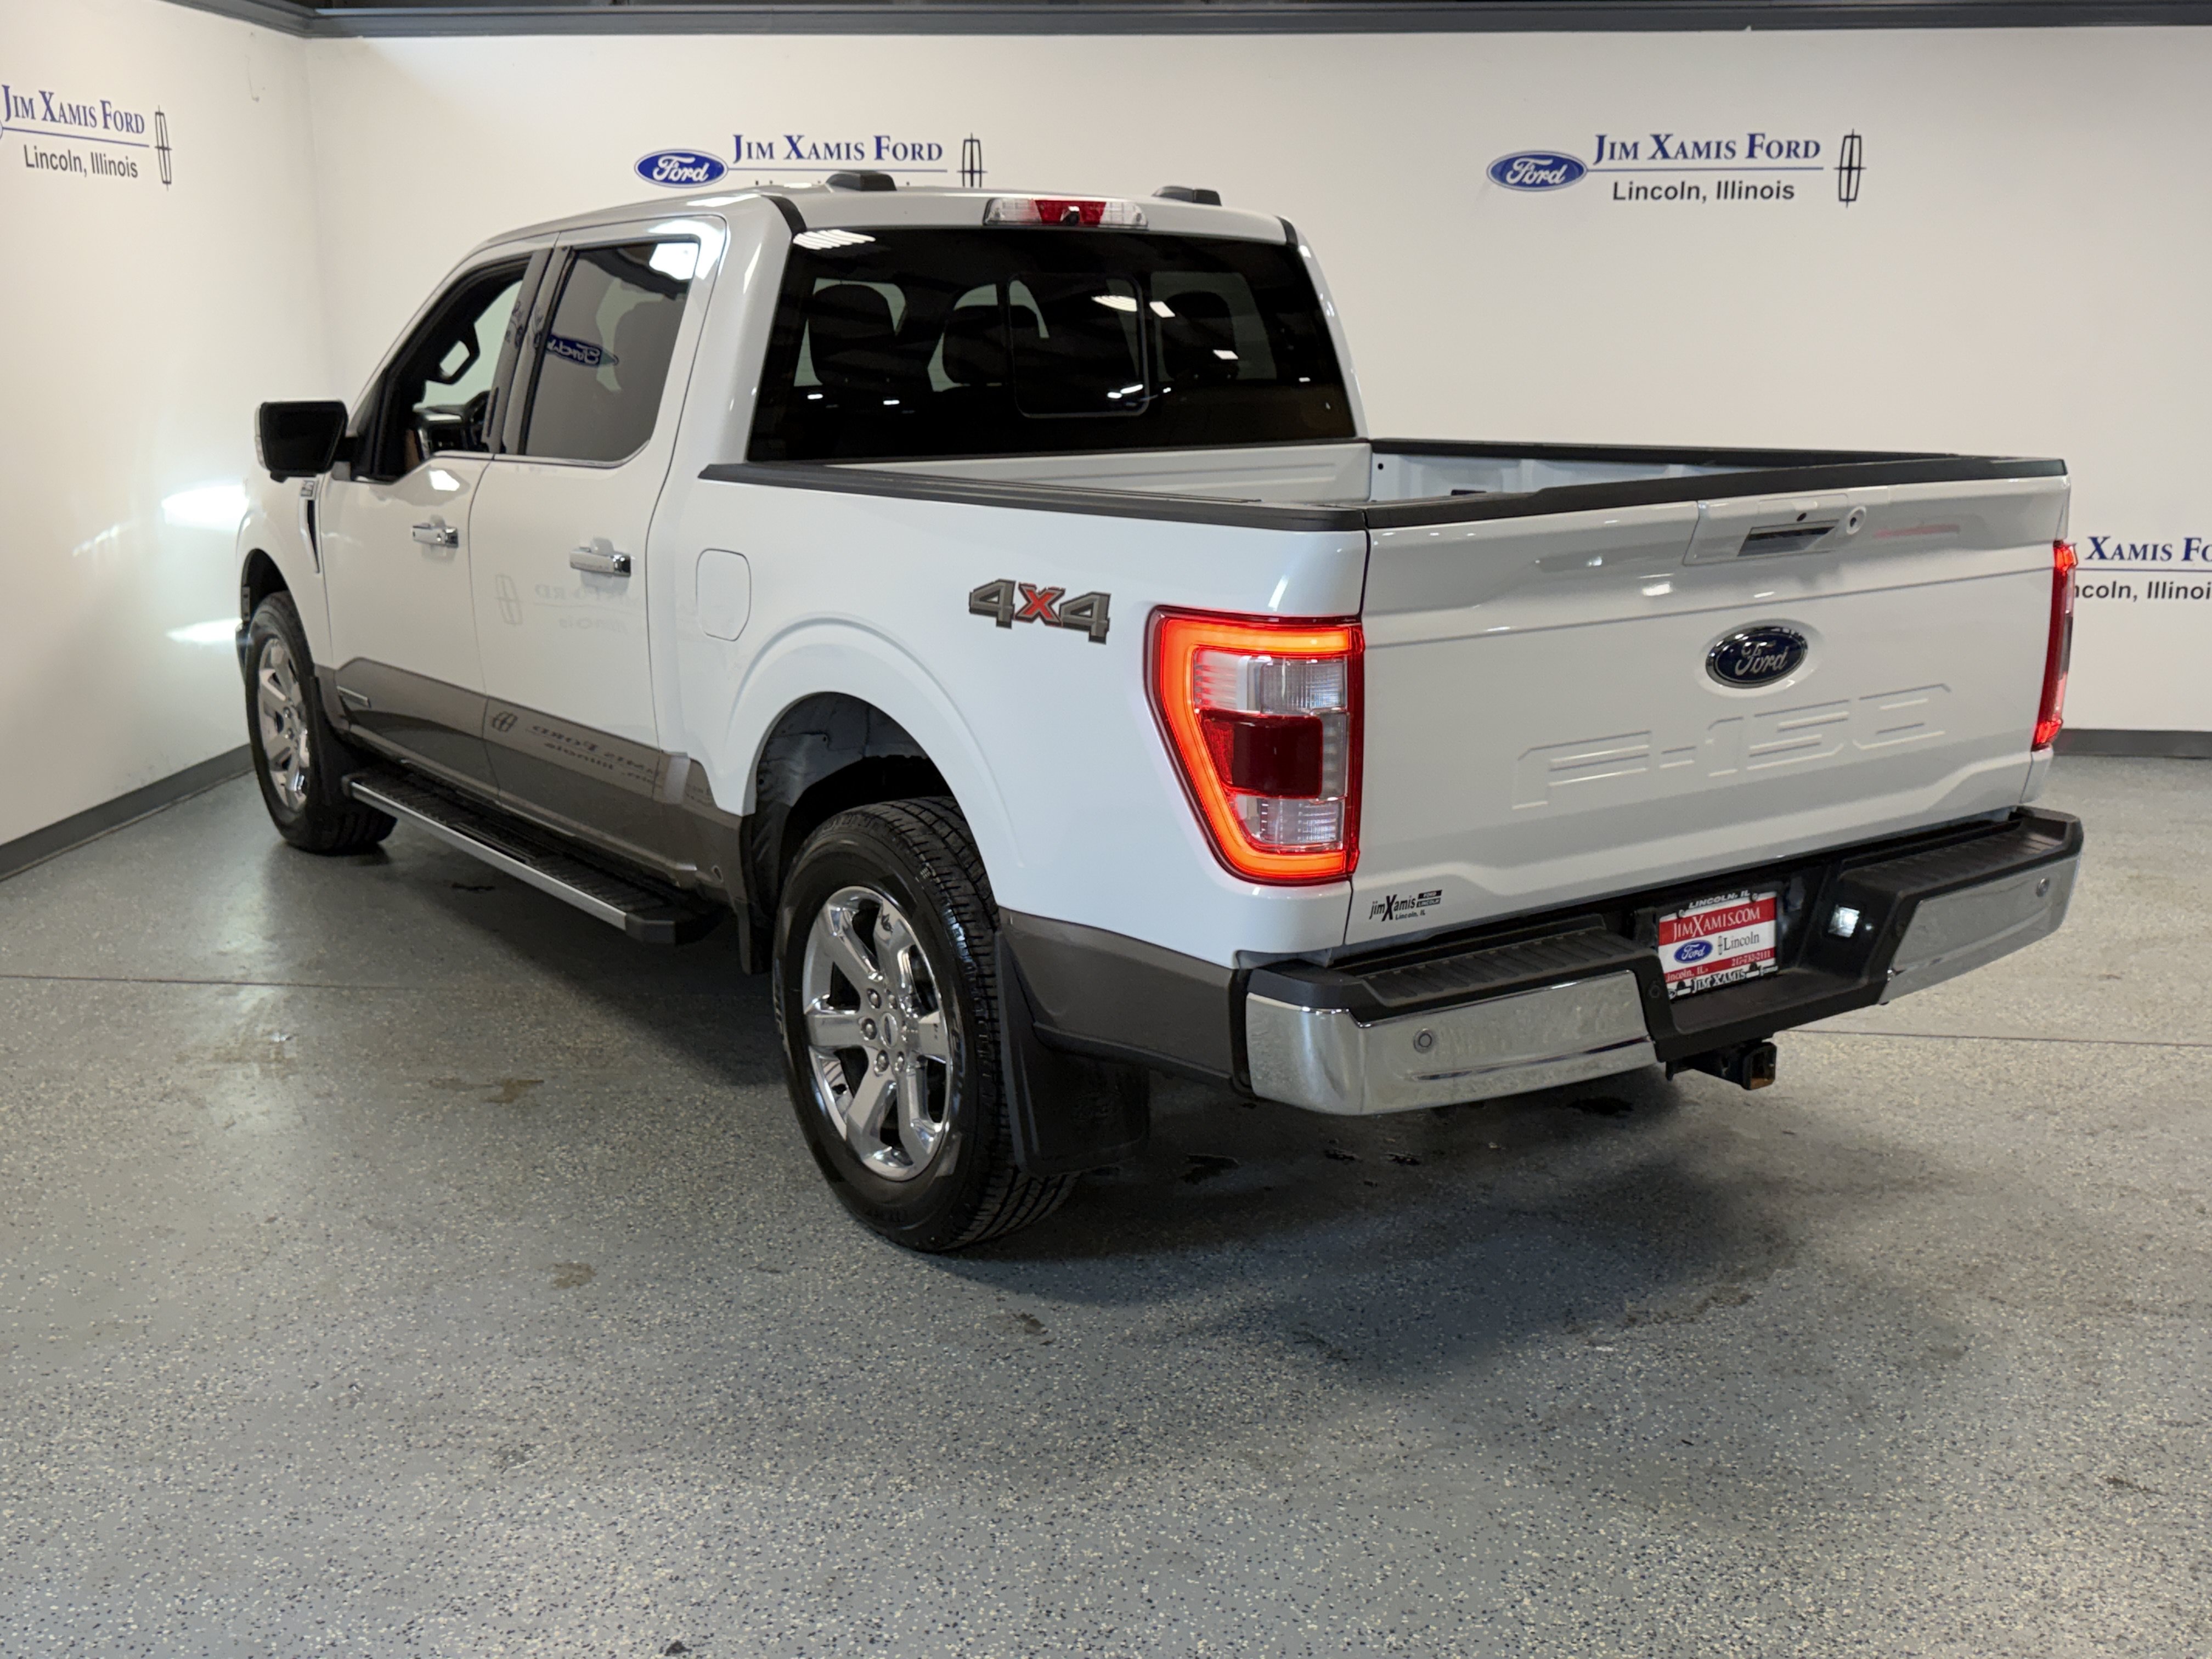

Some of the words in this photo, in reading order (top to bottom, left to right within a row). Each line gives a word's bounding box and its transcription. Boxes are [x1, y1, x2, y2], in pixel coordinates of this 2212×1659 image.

[2, 84, 36, 122] JIM
[38, 90, 97, 128] XAMIS
[100, 99, 145, 134] FORD
[24, 144, 87, 177] Lincoln,
[90, 151, 138, 178] Illinois
[733, 134, 774, 163] JIM
[784, 135, 865, 161] XAMIS
[874, 136, 943, 161] FORD
[1593, 134, 1639, 165] JIM
[1648, 133, 1736, 160] XAMIS
[1745, 132, 1821, 159] FORD
[652, 155, 709, 182] Ford
[1506, 157, 1568, 184] Ford
[1613, 180, 1707, 202] Lincoln,
[1716, 180, 1795, 200] Illinois
[2085, 535, 2172, 562] XAMIS
[1734, 640, 1790, 676] Ford
[1681, 943, 1706, 961] Ford
[1723, 931, 1760, 952] Lincoln
